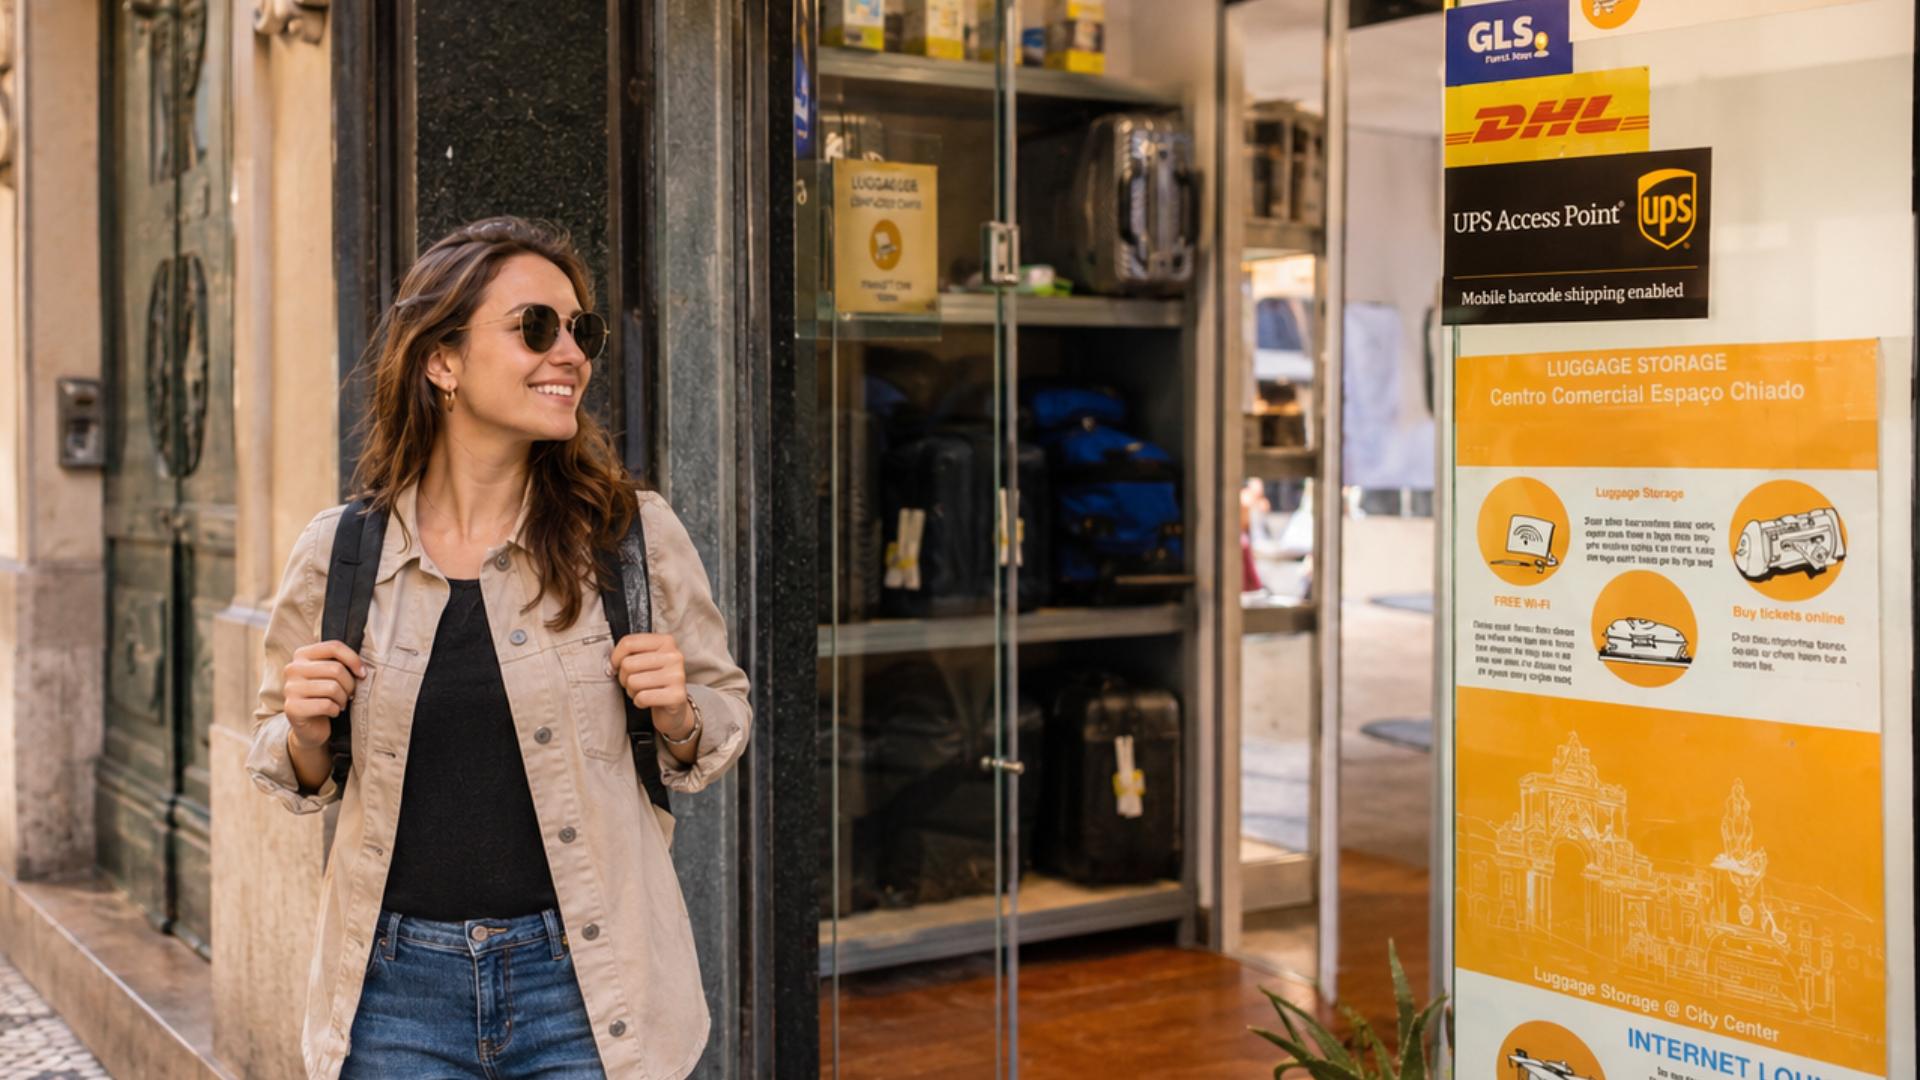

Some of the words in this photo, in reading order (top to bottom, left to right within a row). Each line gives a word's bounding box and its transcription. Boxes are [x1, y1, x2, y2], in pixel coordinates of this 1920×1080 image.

[1468, 15, 1534, 53] GLS
[1472, 95, 1622, 144] DHL
[1453, 211, 1492, 233] UPS
[1495, 210, 1561, 231] Access
[1642, 194, 1692, 237] ups
[1461, 290, 1506, 305] Mobile
[1508, 287, 1561, 304] barcode
[1564, 285, 1625, 305] shipping
[1627, 282, 1684, 299] enabled
[1547, 357, 1632, 377] LUGGAGE
[1638, 353, 1727, 373] STORAGE
[1490, 387, 1546, 406] Centro
[1551, 384, 1644, 405] Comercial
[1651, 383, 1724, 407] Espaço
[1730, 380, 1805, 401] Chiado
[1494, 596, 1521, 608] FREE
[1733, 606, 1757, 621] Buy
[1760, 607, 1802, 622] tickets
[1805, 612, 1845, 625] online
[1534, 966, 1596, 996] Luggage
[1601, 983, 1660, 1012] Storage
[1664, 1000, 1680, 1018] @
[1685, 1005, 1719, 1029] City
[1724, 1014, 1780, 1042] Center
[1628, 1027, 1751, 1078] INTERNET
